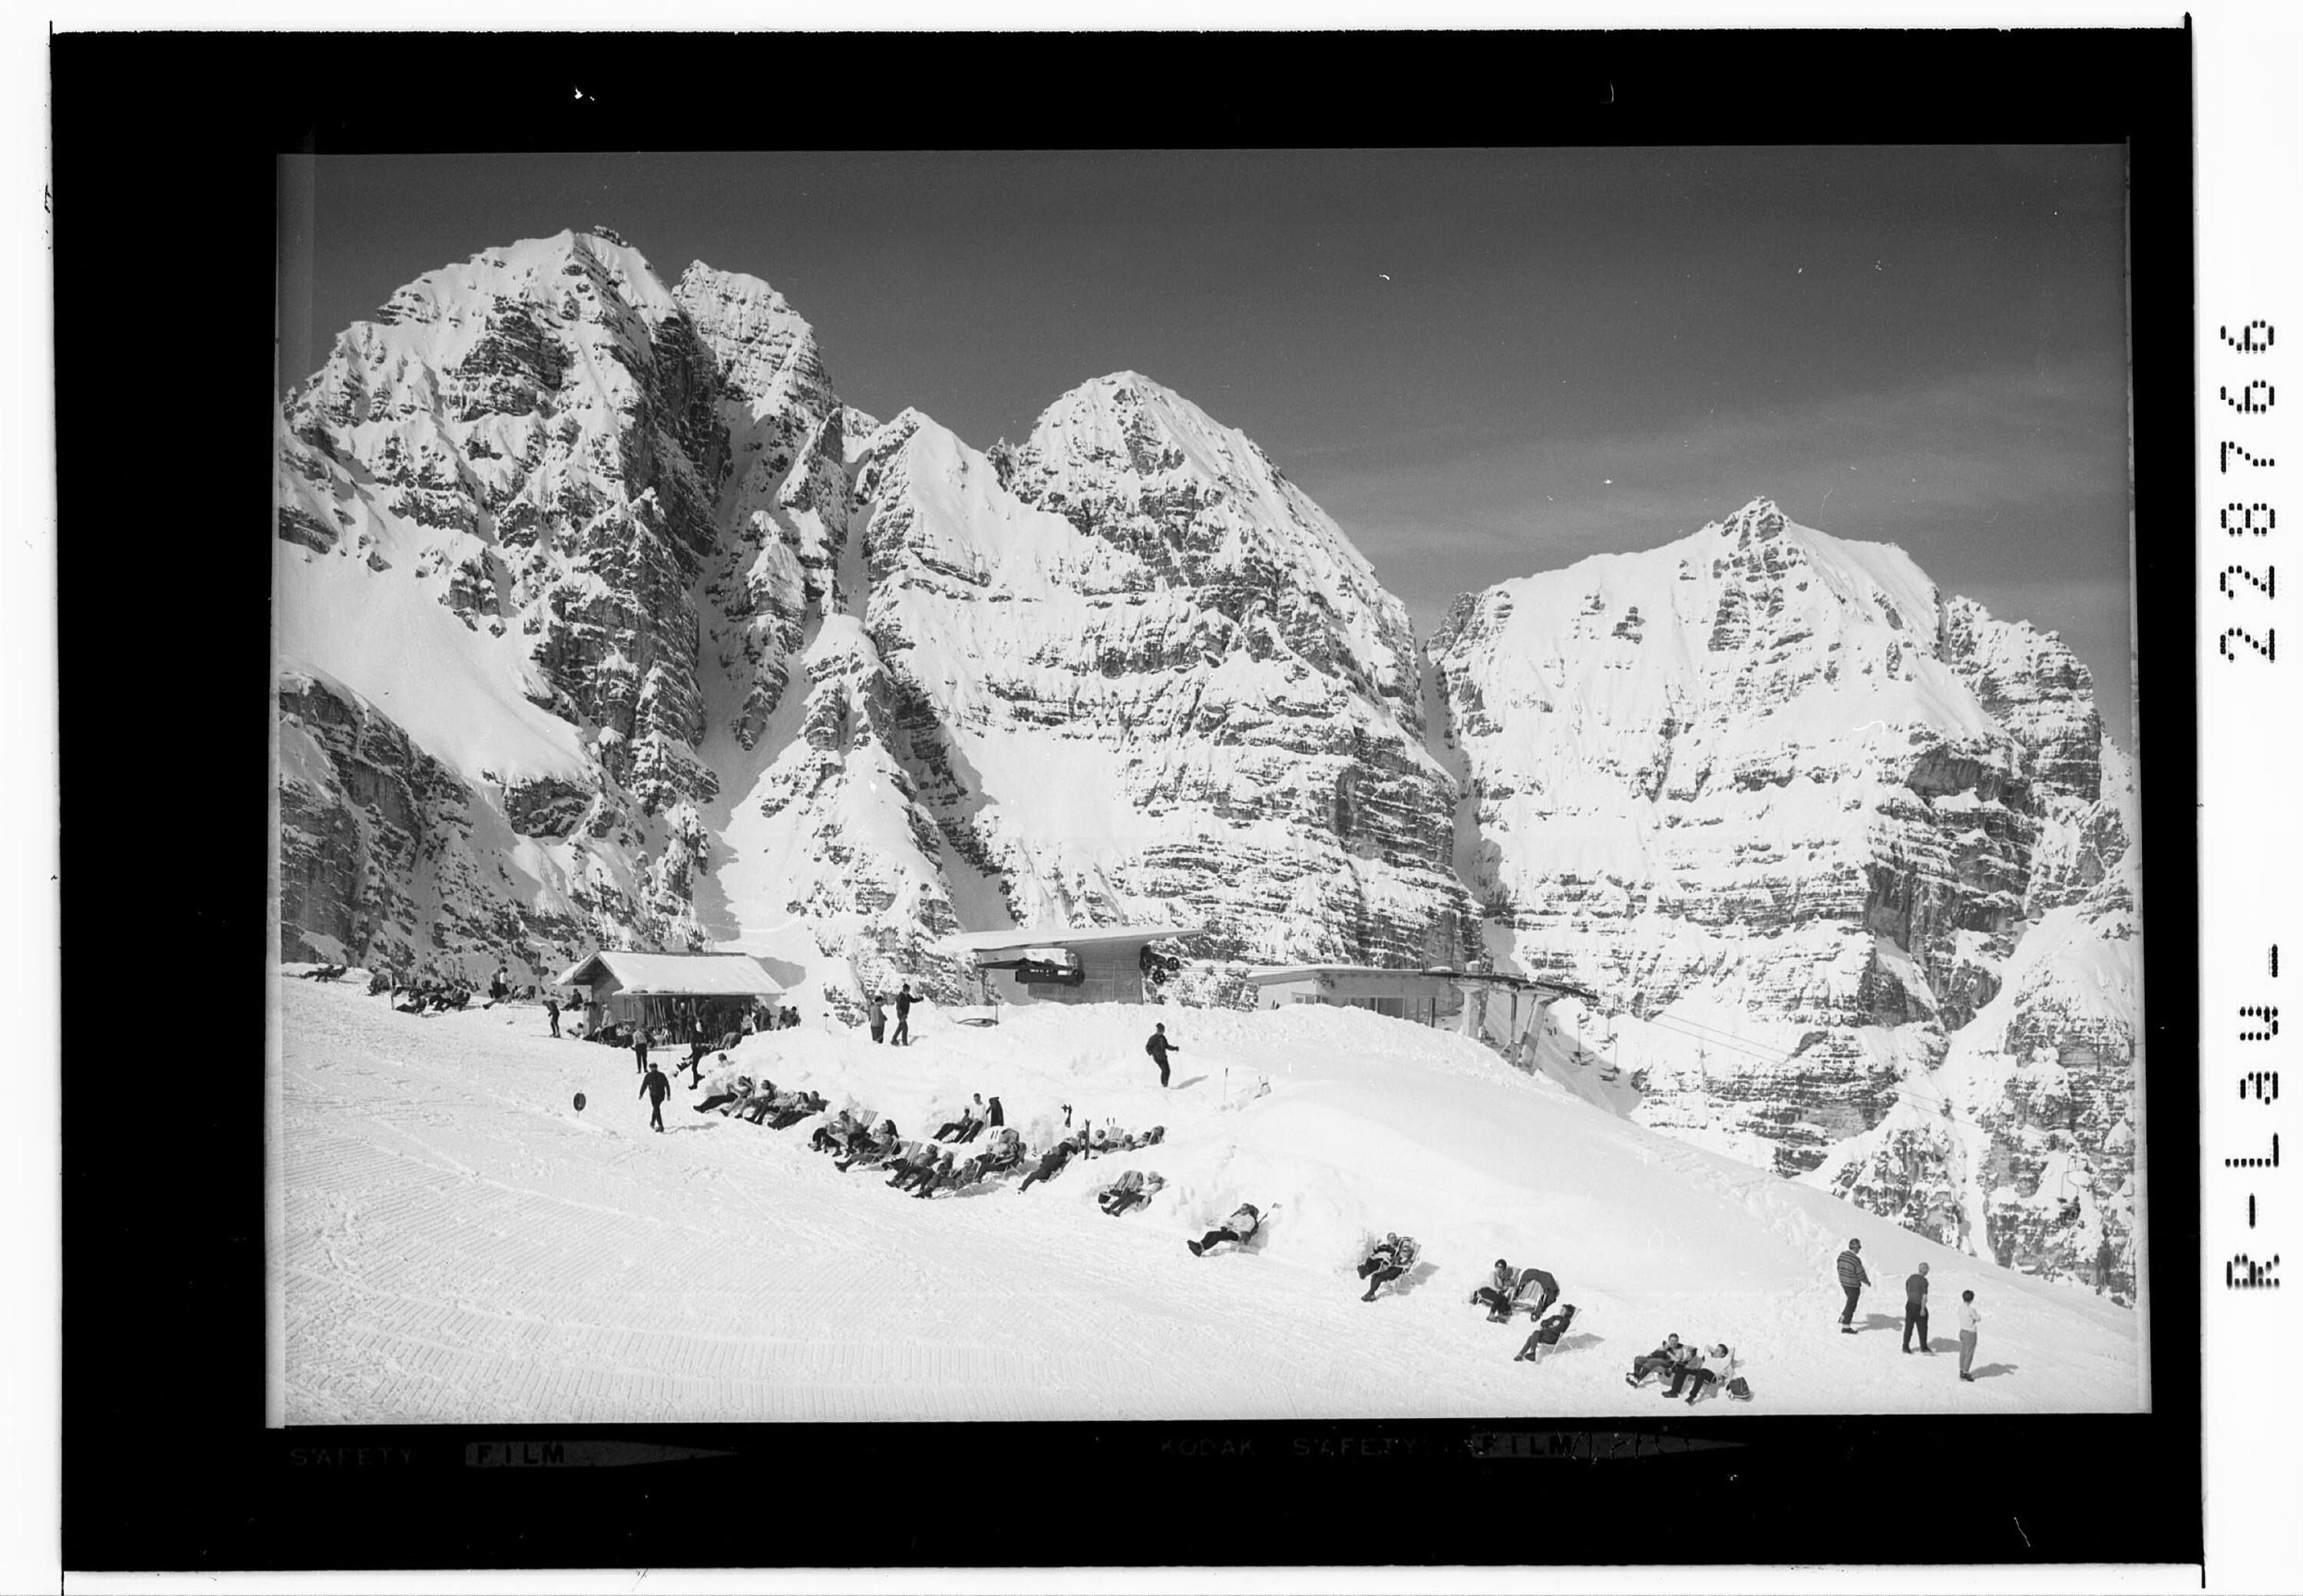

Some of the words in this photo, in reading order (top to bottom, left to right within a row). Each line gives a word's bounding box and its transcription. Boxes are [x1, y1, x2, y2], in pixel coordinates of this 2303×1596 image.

[477, 1442, 565, 1465] FILM
[1160, 1437, 1256, 1457] KODAK
[1480, 1433, 1572, 1456] FILM
